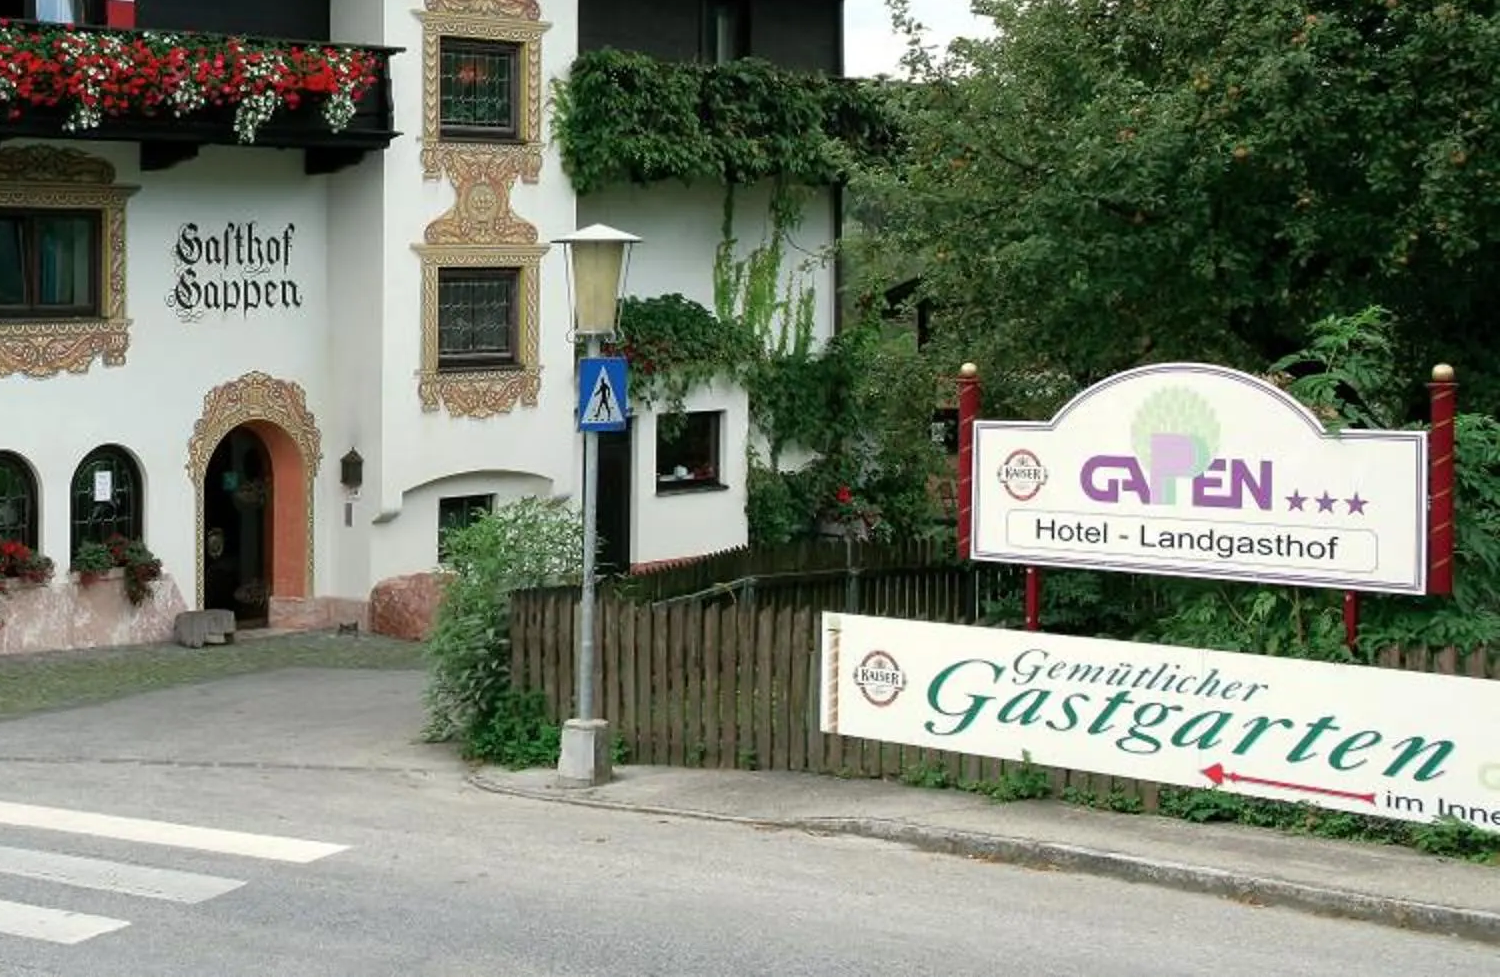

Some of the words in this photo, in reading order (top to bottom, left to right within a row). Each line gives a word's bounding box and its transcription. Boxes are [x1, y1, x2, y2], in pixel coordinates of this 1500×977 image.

[171, 220, 295, 275] Gasthof
[164, 267, 303, 323] Gappen
[1035, 518, 1108, 544] Hotel
[1140, 523, 1339, 560] Landgasthof
[1012, 649, 1268, 702] Gemütlicher
[924, 658, 1455, 782] Gastgarten
[1386, 790, 1423, 813] im
